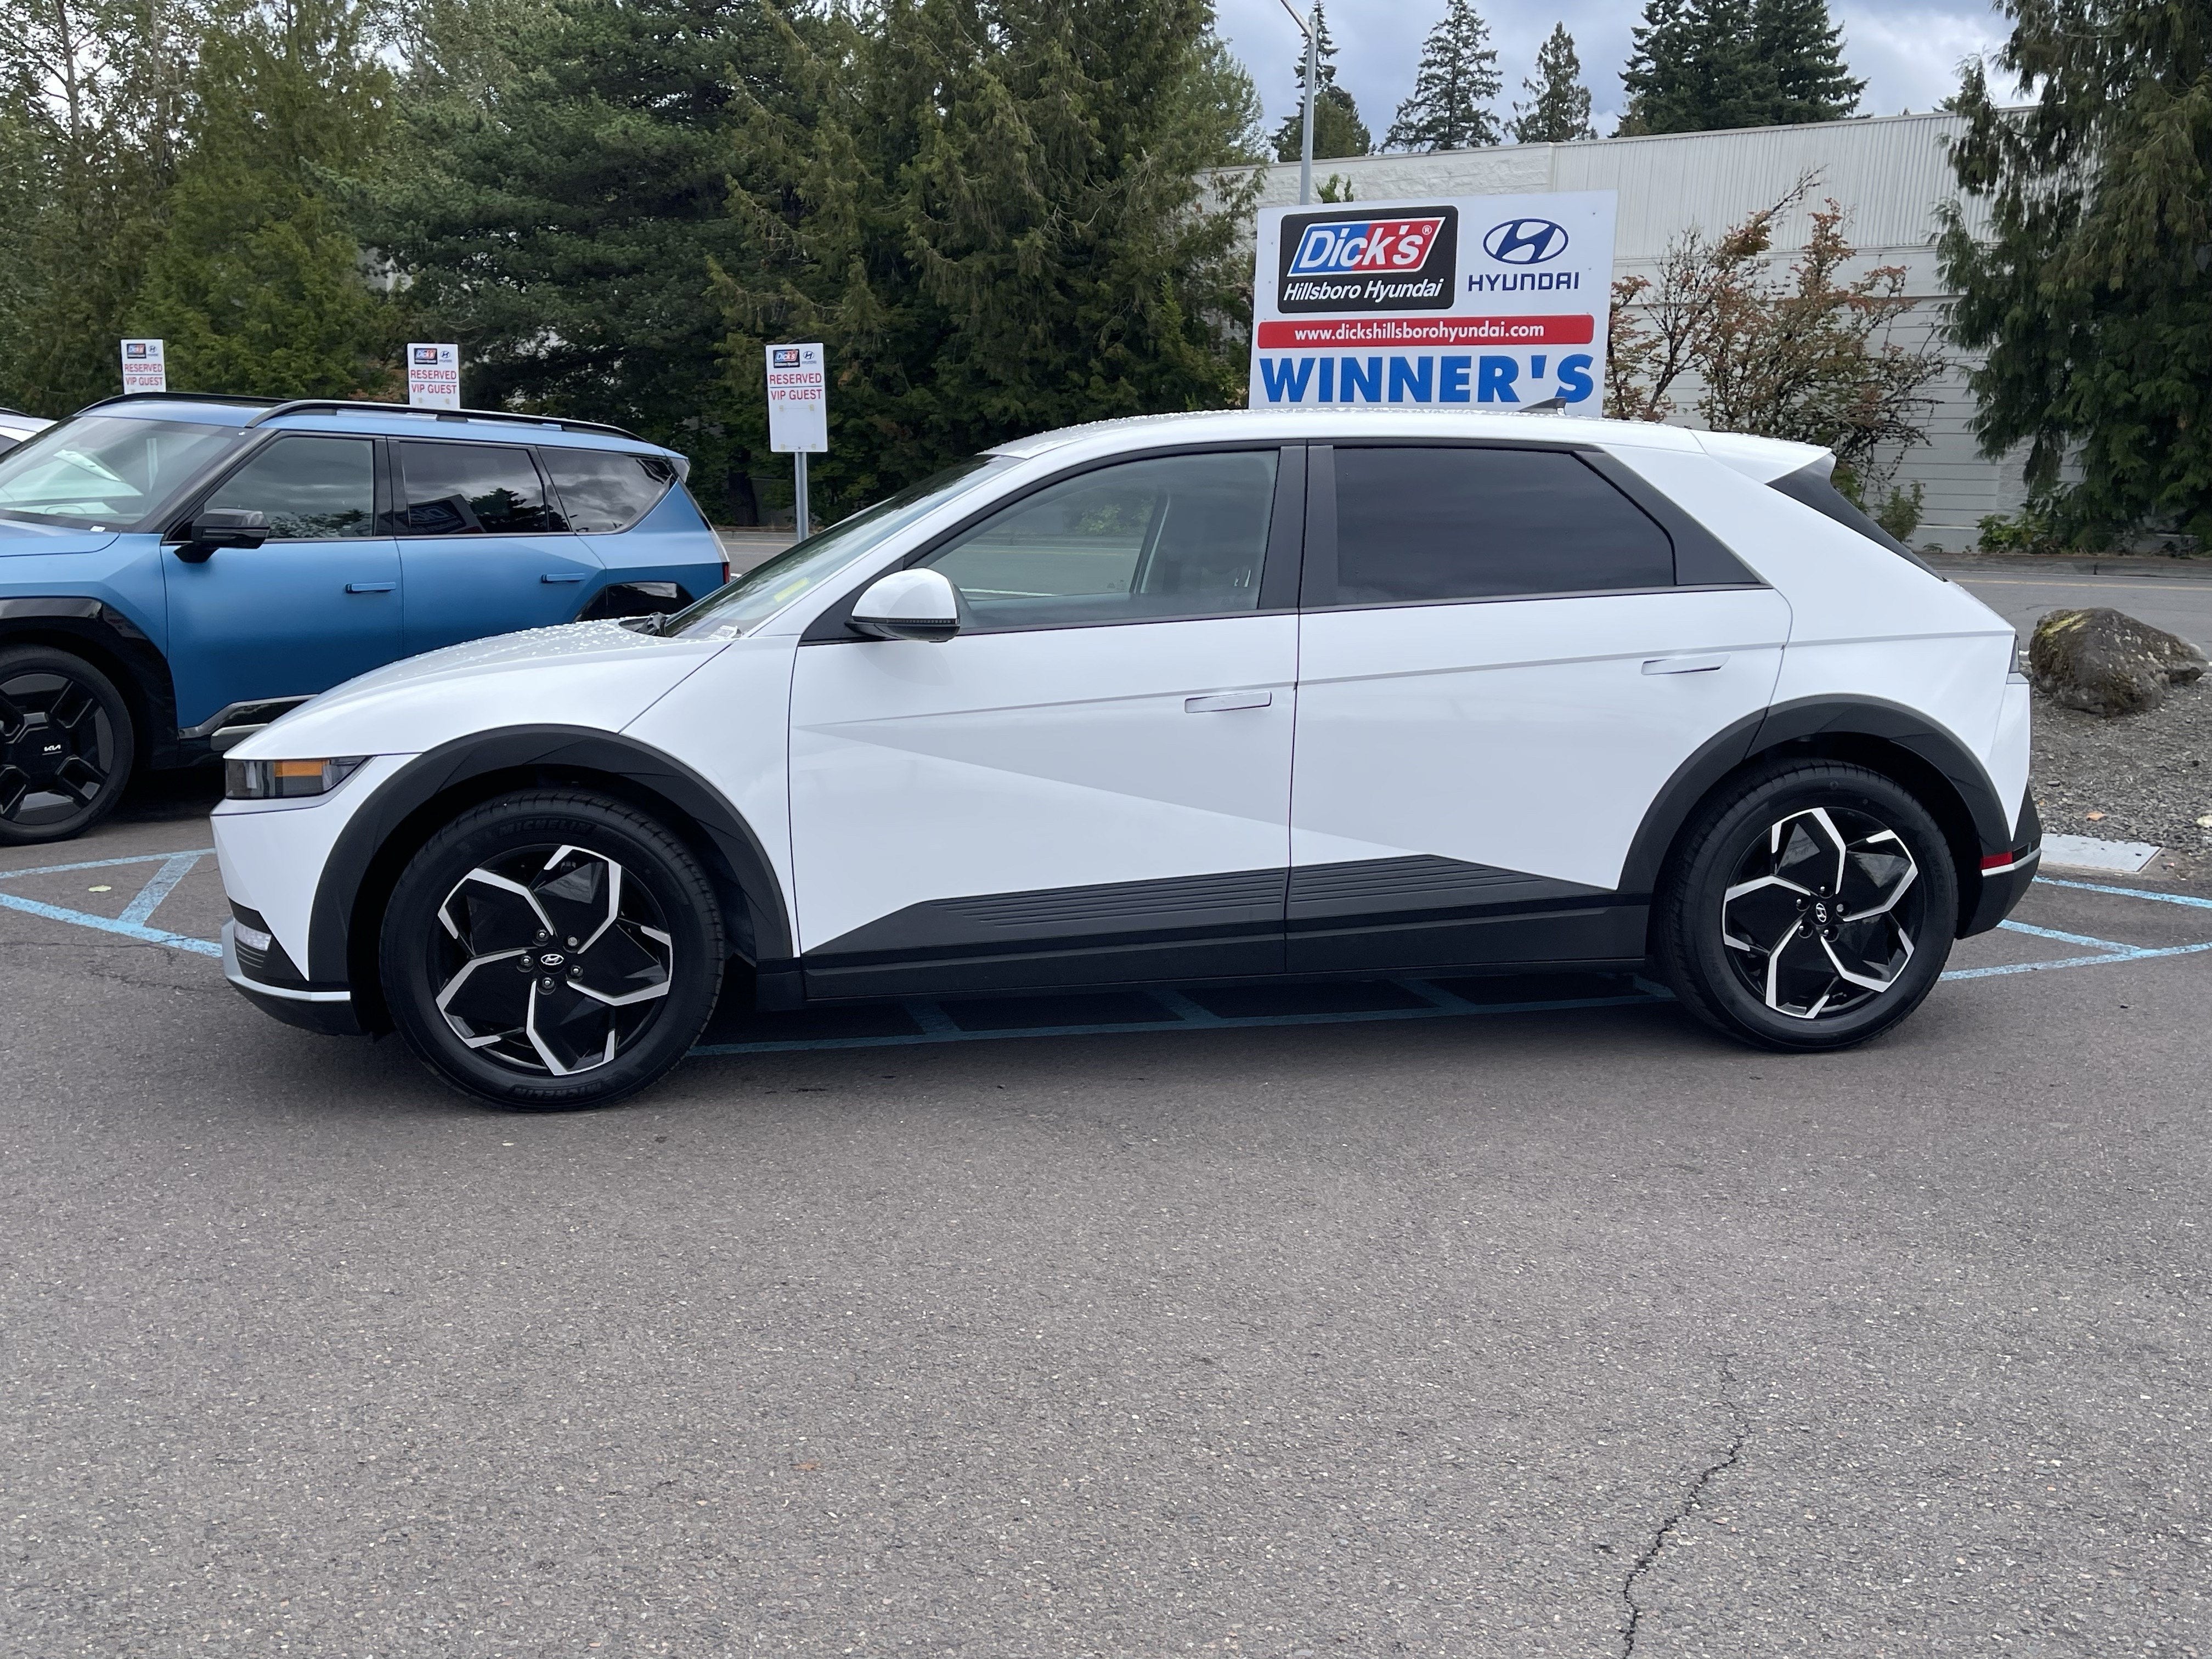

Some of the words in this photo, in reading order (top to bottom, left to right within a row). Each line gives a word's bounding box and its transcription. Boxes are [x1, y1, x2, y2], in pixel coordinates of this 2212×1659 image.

[1468, 272, 1579, 292] HYUNDAI
[1283, 281, 1362, 301] Hillsboro
[1363, 278, 1444, 303] Hyundai
[1294, 321, 1544, 343] www.dickshillsborohyundai.com
[125, 364, 163, 373] RESERVED
[410, 370, 456, 380] RESERVED
[769, 373, 822, 385] RESERVED
[1259, 353, 1594, 403] WINNER'S
[126, 377, 137, 385] VIP
[139, 377, 163, 386] GUEST
[411, 383, 425, 393] VIP
[427, 384, 457, 394] GUEST
[770, 390, 786, 400] VIP
[789, 389, 822, 400] GUEST
